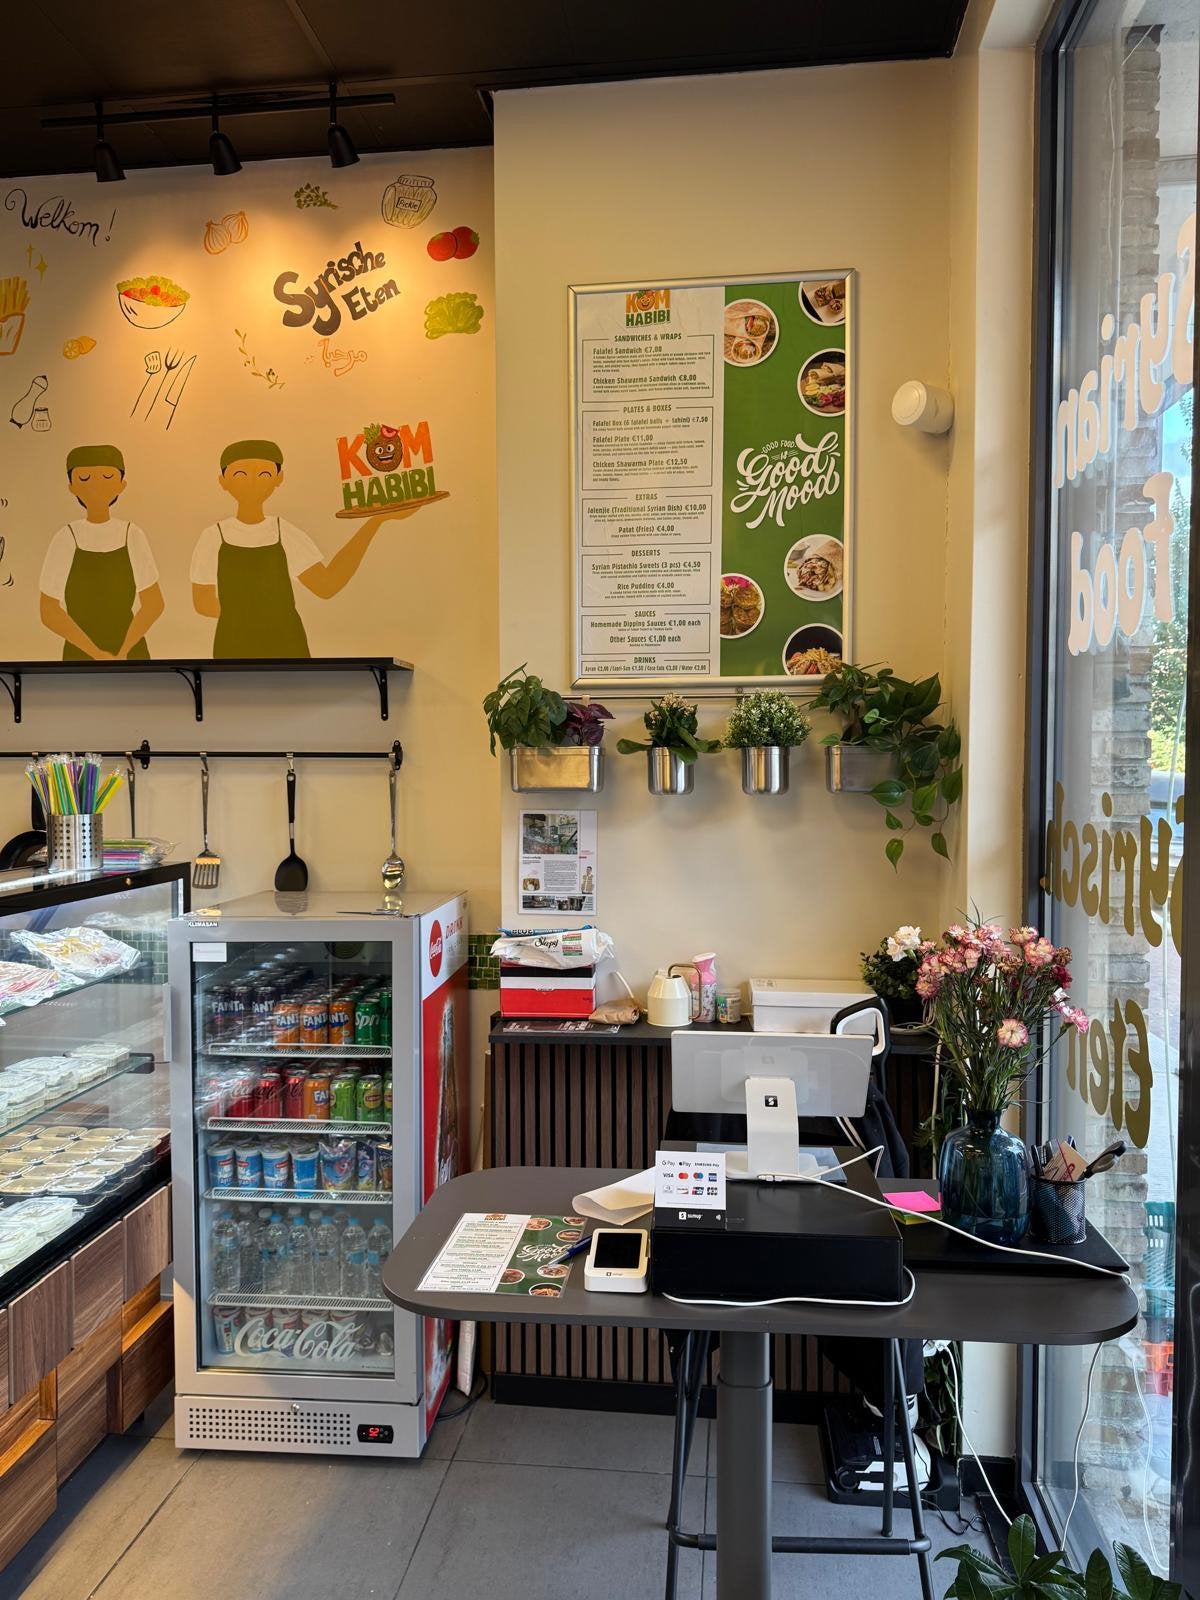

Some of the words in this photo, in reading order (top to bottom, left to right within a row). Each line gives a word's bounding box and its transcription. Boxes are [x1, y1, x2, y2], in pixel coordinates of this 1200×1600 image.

[273, 241, 387, 336] Syrische
[342, 279, 401, 321] Eten
[625, 309, 671, 326] HABIBI
[614, 334, 651, 342] SANDWICHES
[593, 377, 615, 385] Chicken
[617, 376, 647, 384] Shawarma
[623, 405, 644, 413] PLATES
[652, 404, 672, 412] BOXES
[780, 440, 796, 448] FOOD
[730, 432, 839, 513] Good
[342, 466, 436, 511] HABIBI
[745, 457, 840, 529] Mood
[612, 562, 638, 570] Pistachio
[623, 620, 645, 628] Dipping
[634, 656, 656, 664] DRINKS
[303, 1013, 327, 1026] FANT
[234, 1318, 367, 1362] Coca-Cola
